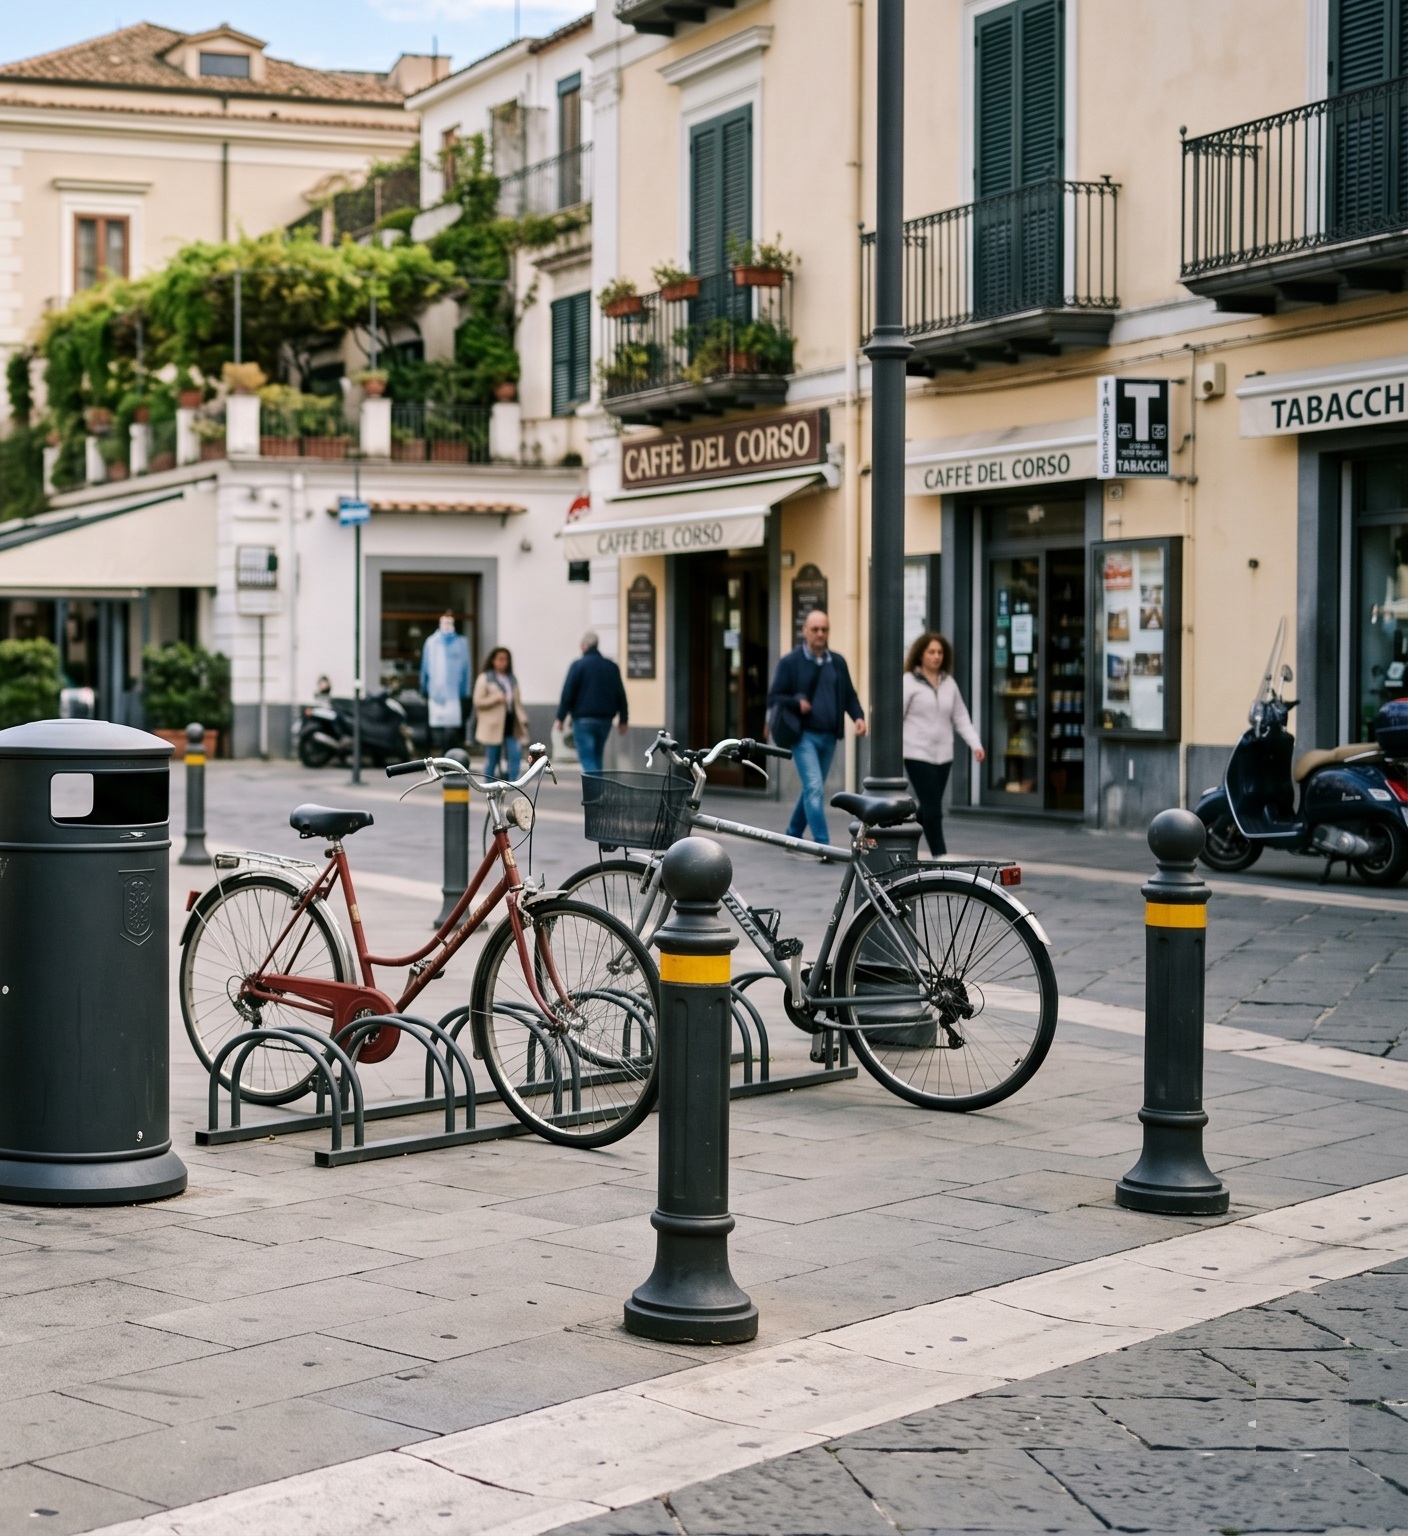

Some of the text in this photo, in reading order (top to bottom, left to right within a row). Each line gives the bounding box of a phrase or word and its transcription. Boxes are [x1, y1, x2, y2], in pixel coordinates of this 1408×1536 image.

[1124, 383, 1160, 441] T
[1271, 383, 1405, 429] TABACCH
[624, 420, 810, 481] CAFFÈ DEL CORSO
[1117, 460, 1167, 473] TABACCHI
[924, 453, 1070, 490] CAFFÈ DEL CORSO
[642, 528, 667, 551] DEL
[672, 522, 723, 548] CORSO
